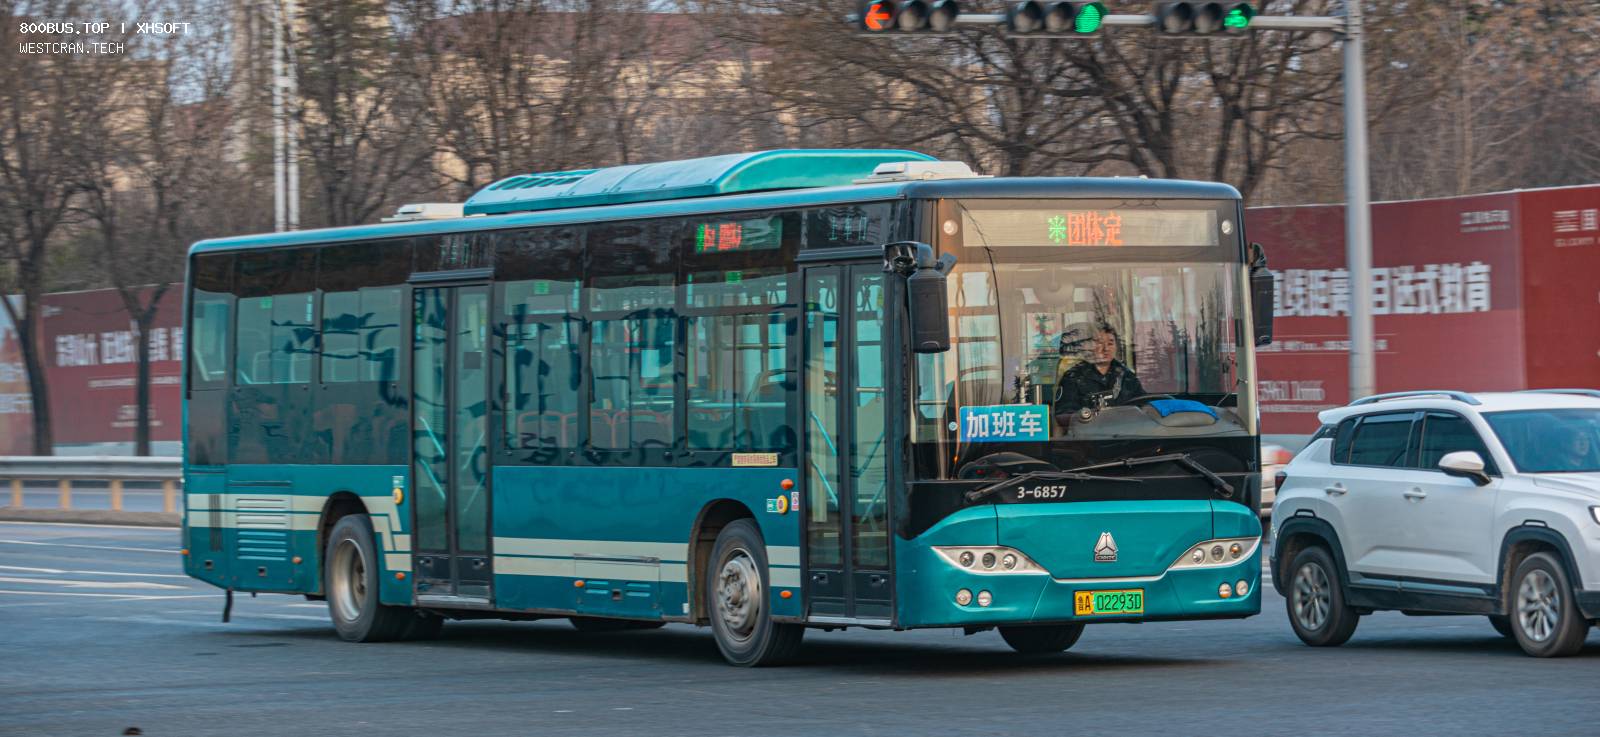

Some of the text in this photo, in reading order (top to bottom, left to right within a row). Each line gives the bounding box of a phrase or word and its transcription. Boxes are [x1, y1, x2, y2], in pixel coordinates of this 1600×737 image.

[966, 411, 1042, 438] 加班车
[1017, 485, 1067, 499] 3-6857
